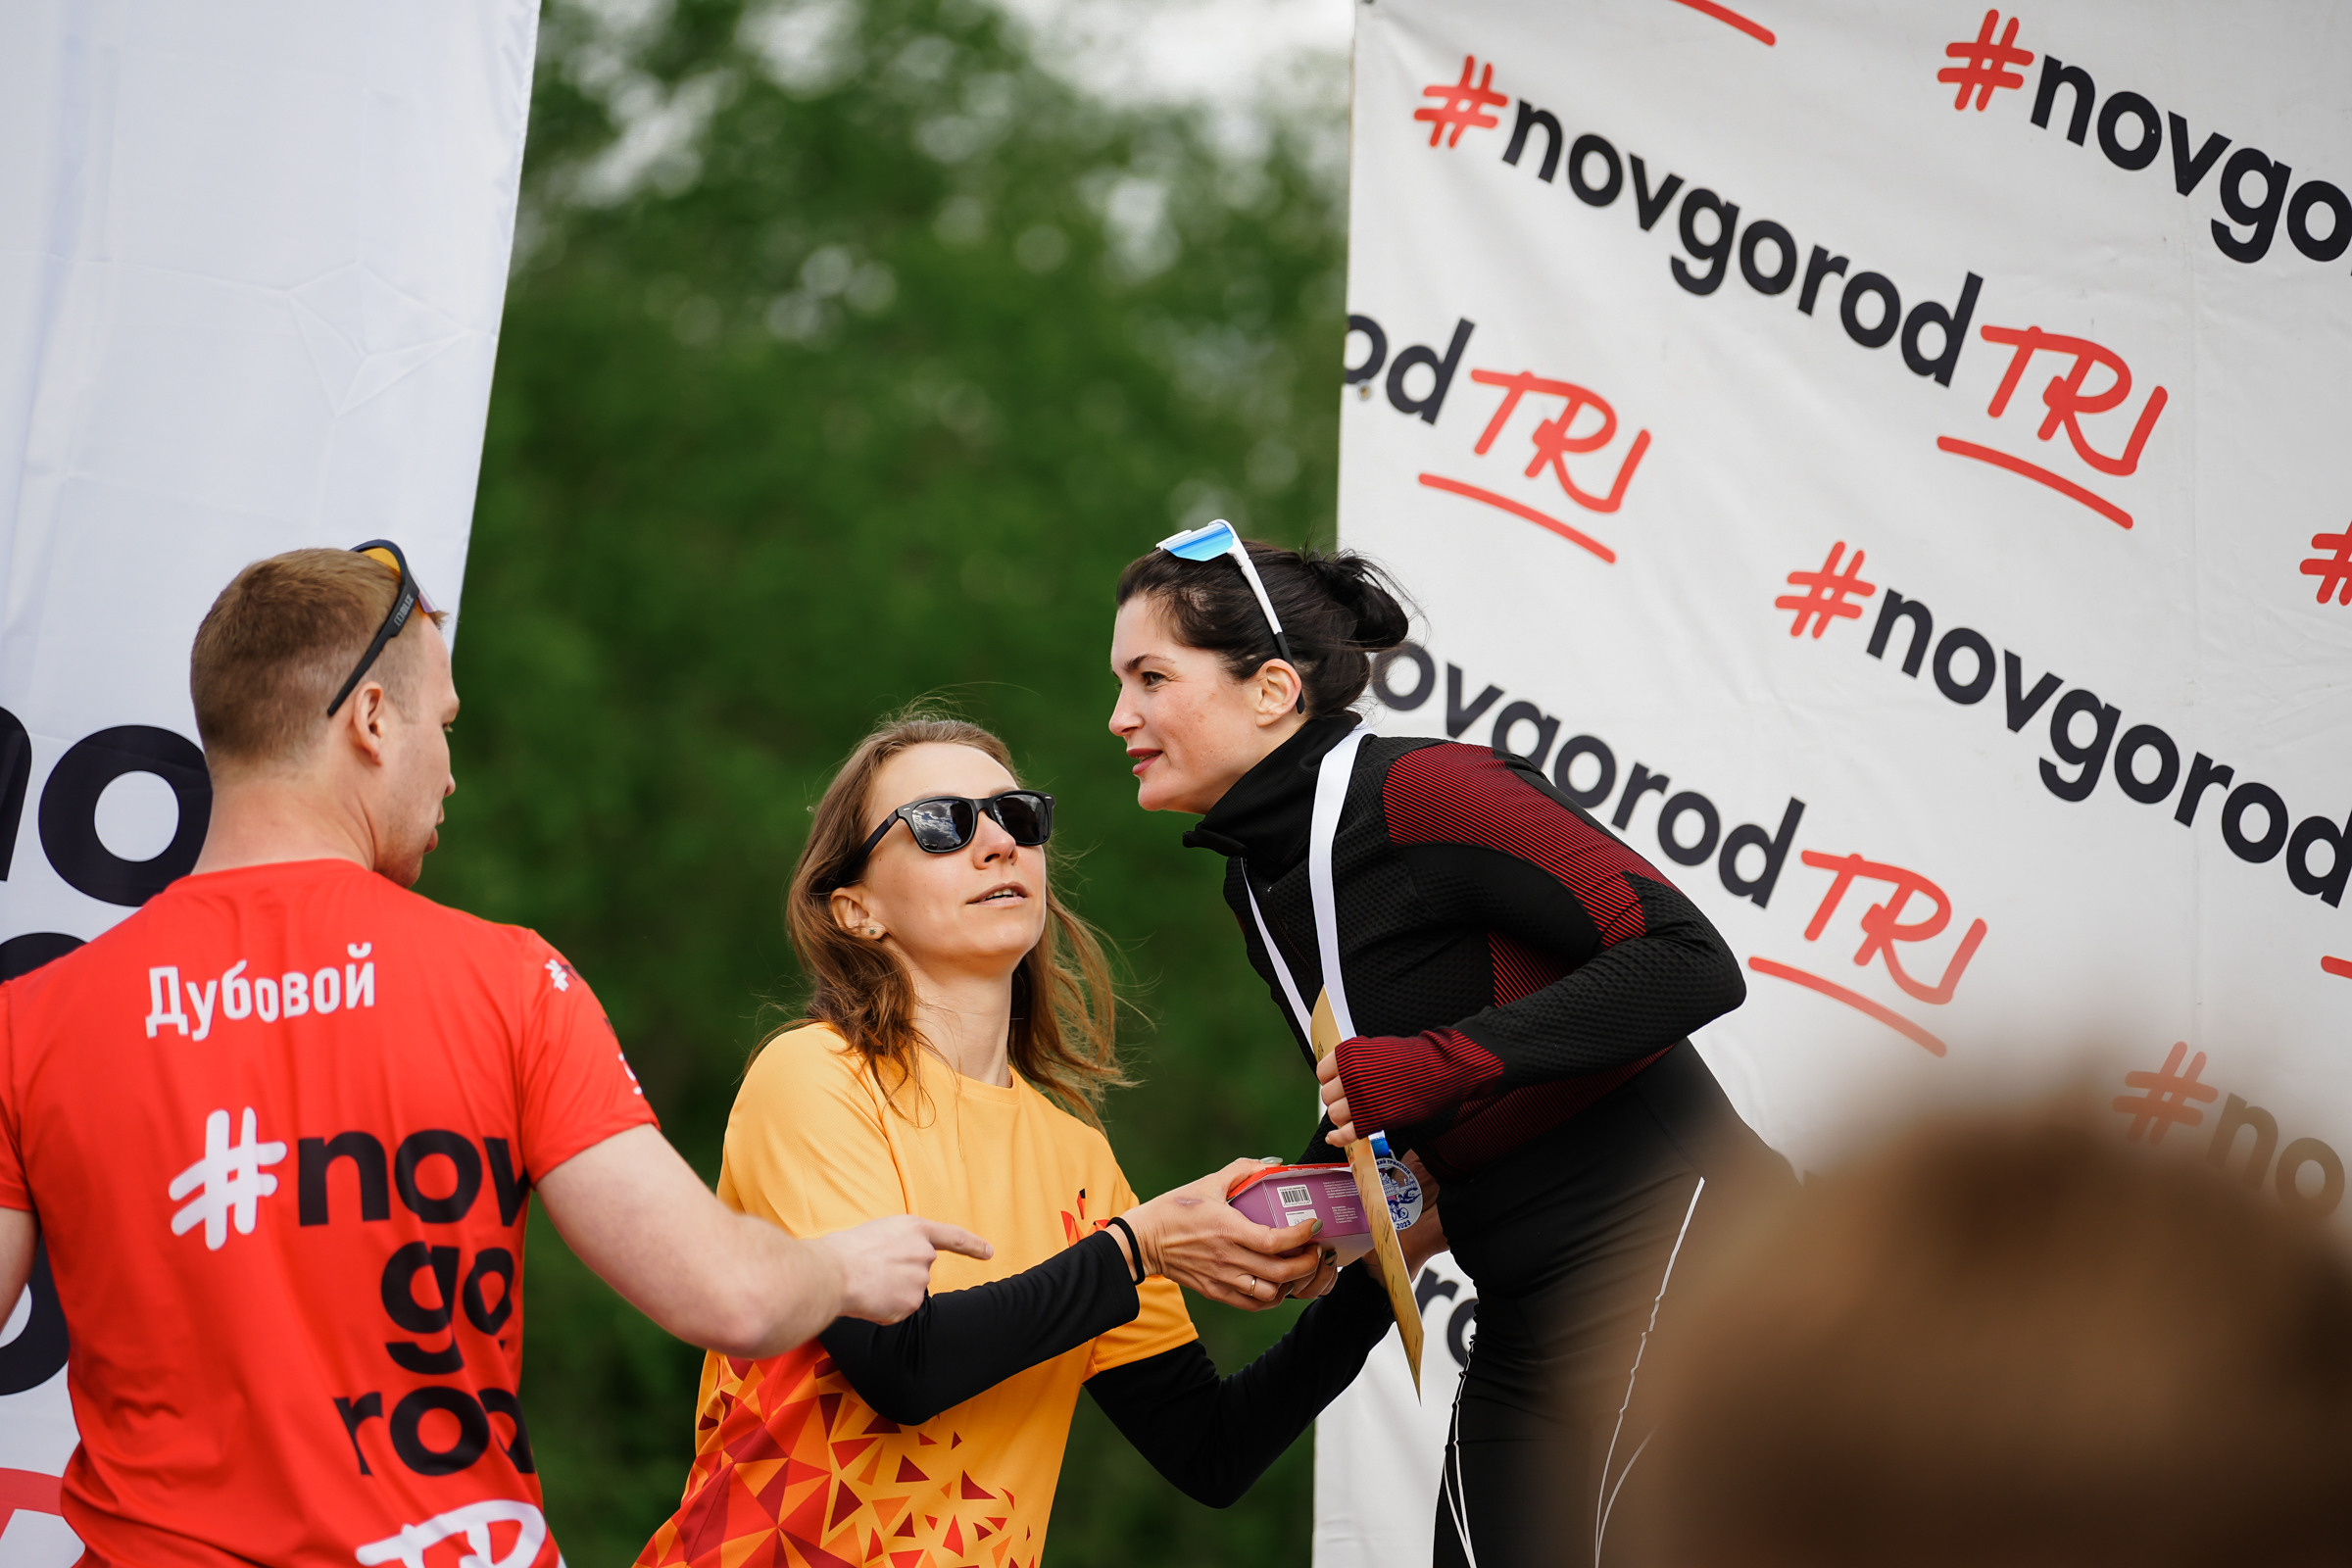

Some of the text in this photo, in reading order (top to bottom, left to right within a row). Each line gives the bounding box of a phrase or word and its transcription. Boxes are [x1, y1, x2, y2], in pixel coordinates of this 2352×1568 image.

[1936, 9, 2352, 264] #novgo
[1775, 541, 2352, 908] #novgorod
[145, 942, 376, 1041] Дубовой
[168, 1106, 532, 1251] #nov
[1396, 1219, 1411, 1229] 2023
[380, 1241, 515, 1375] go
